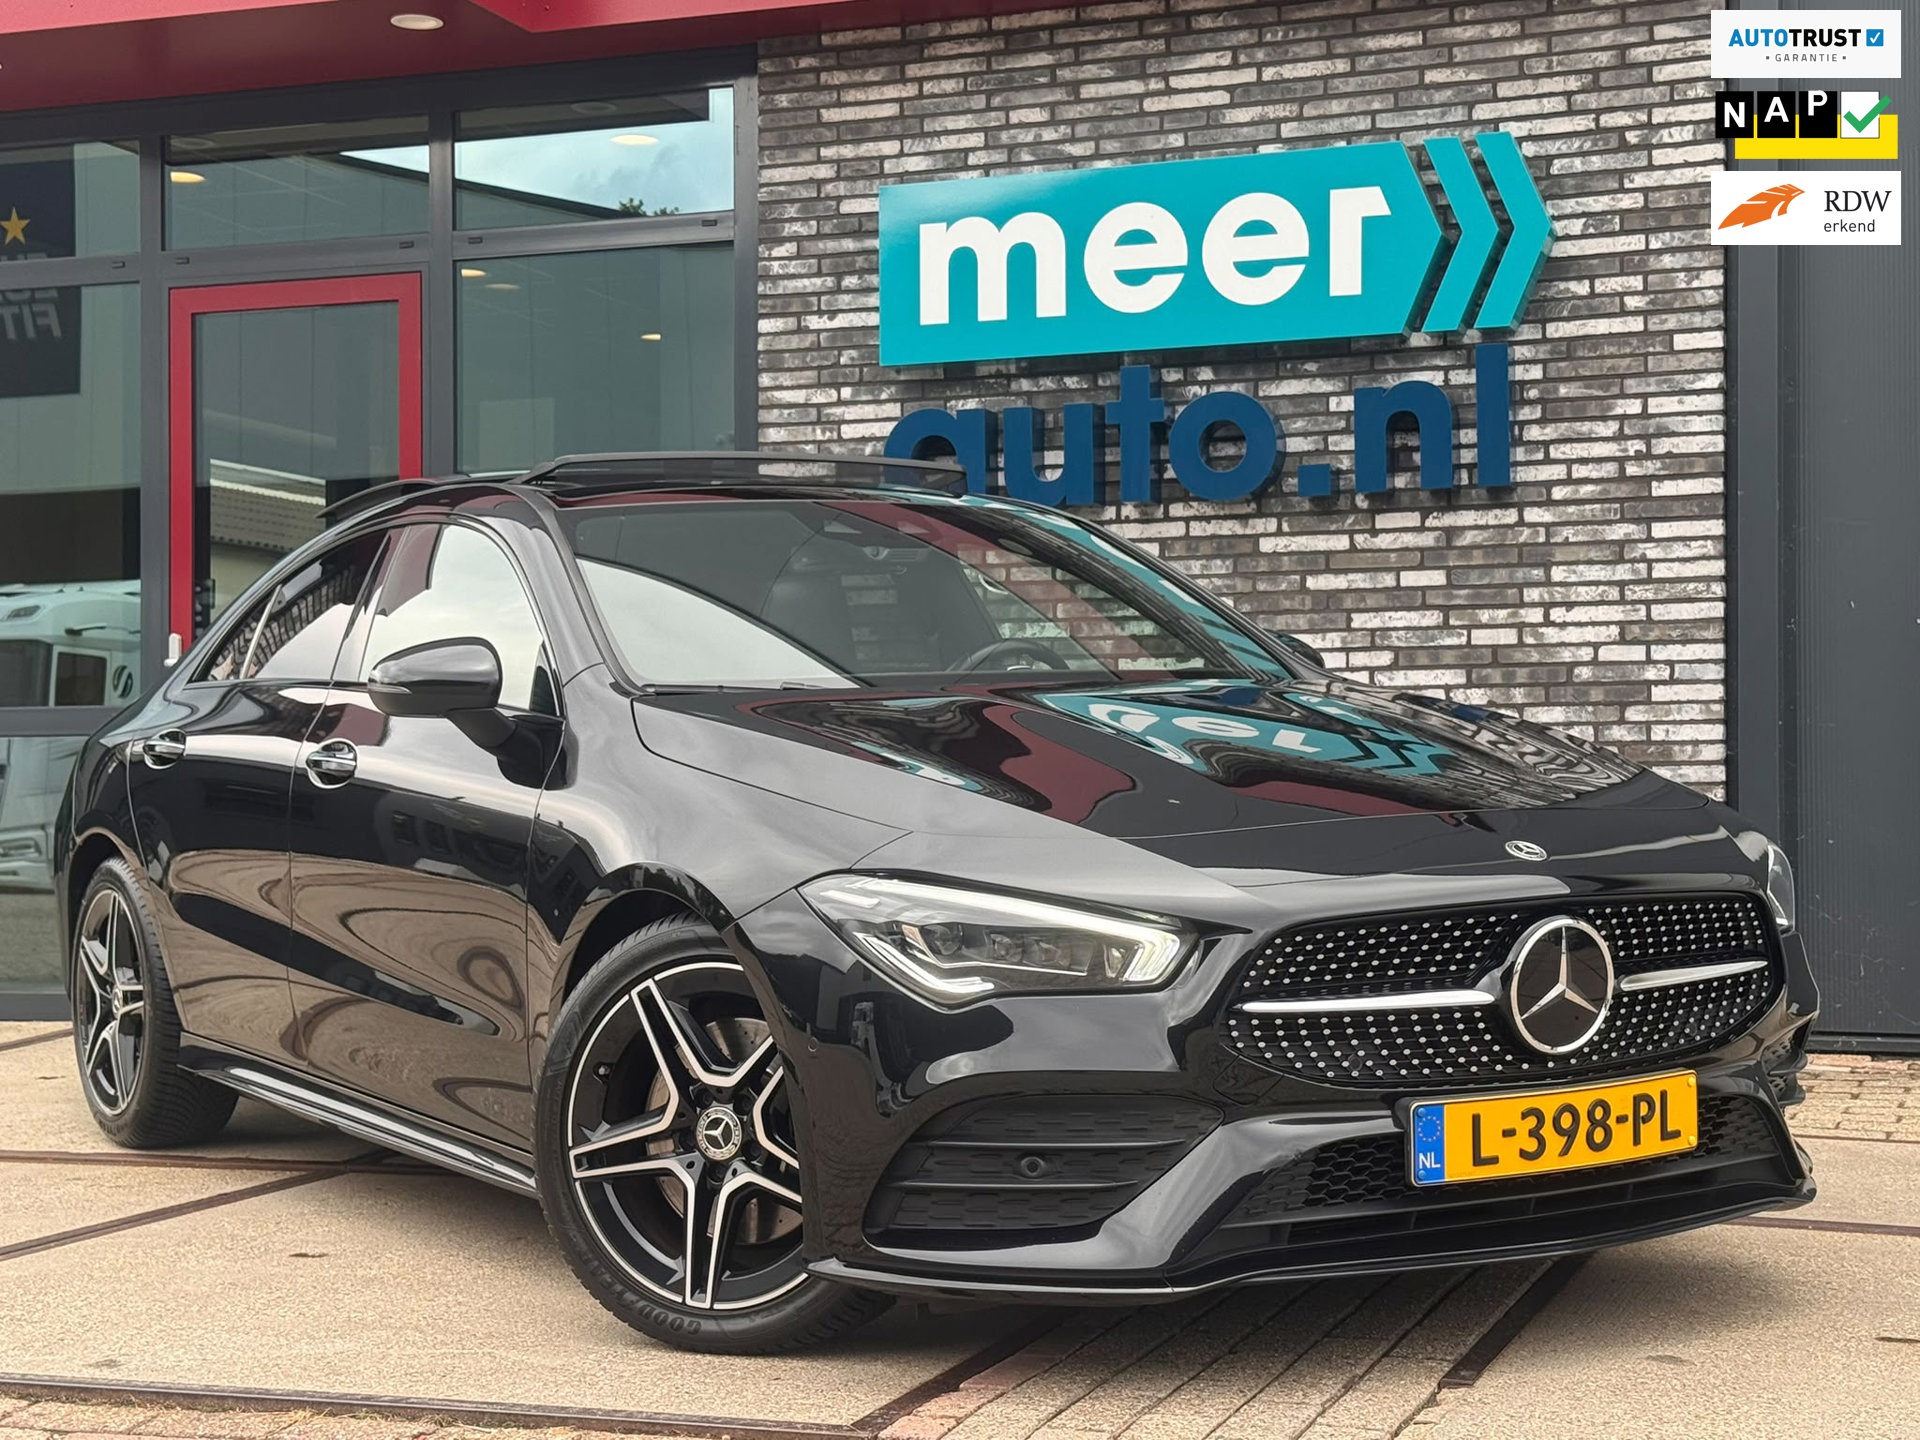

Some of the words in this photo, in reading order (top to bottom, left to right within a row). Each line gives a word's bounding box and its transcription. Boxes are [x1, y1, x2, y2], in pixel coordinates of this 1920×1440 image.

[918, 185, 1393, 326] meer
[884, 342, 1512, 508] auto.nl
[1418, 1151, 1442, 1170] NL
[1471, 1088, 1683, 1168] L-398-PL
